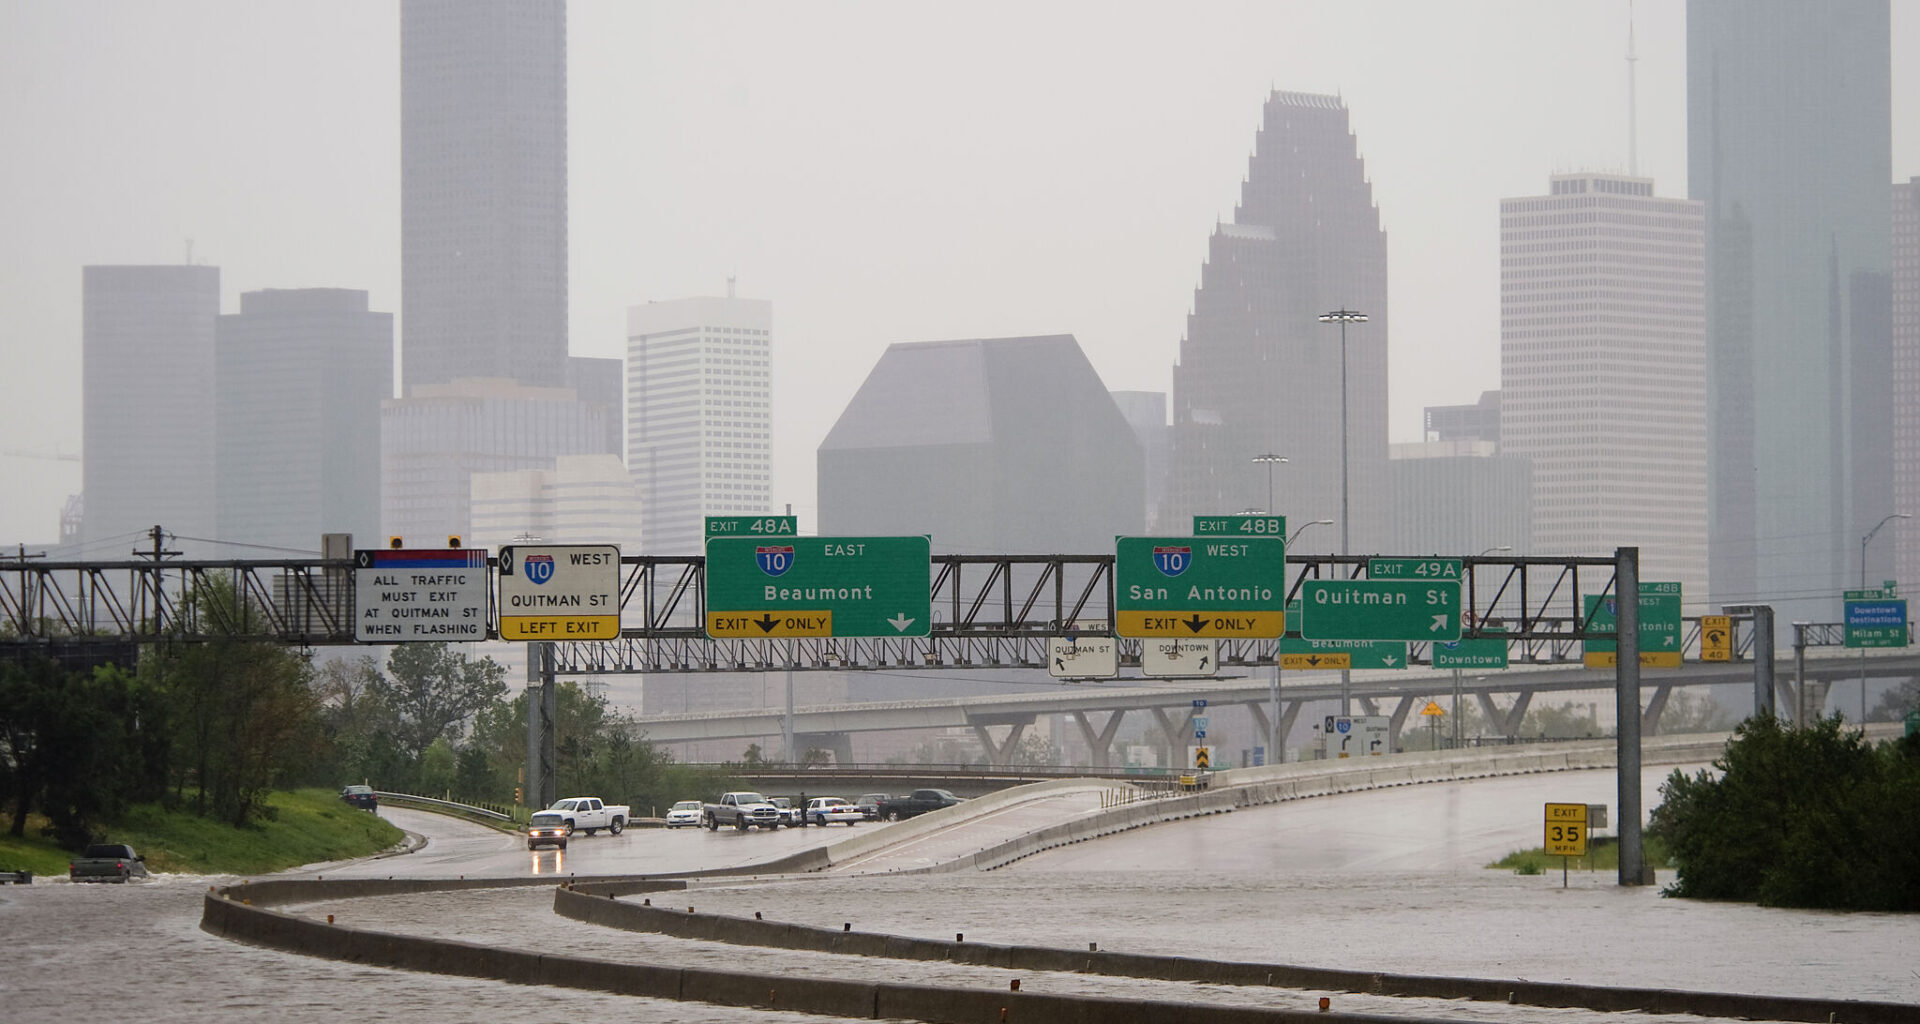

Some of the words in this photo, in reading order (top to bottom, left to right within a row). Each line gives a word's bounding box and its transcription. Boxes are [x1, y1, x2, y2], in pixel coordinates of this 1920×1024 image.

[711, 522, 738, 532] EXIT
[751, 519, 791, 533] 48A
[1200, 521, 1227, 531] EXIT
[1240, 519, 1279, 533] 48B
[825, 545, 865, 556] EAST
[1207, 545, 1248, 556] WEST
[570, 553, 611, 565] WEST
[765, 553, 785, 570] 10
[1162, 553, 1183, 570] 10
[530, 562, 550, 579] 10
[1374, 564, 1402, 574] EXIT
[1415, 563, 1456, 577] 49A
[373, 576, 398, 585] ALL
[411, 575, 466, 585] TRAFFIC
[764, 585, 872, 600] Beaumont
[1130, 585, 1167, 600] San
[1188, 585, 1272, 600] Antonio
[1655, 583, 1678, 592] 48B
[382, 592, 417, 601] MUST
[429, 592, 457, 601] EXIT
[511, 595, 580, 607] QUITMAN
[589, 594, 608, 606] ST
[1315, 589, 1406, 605] Quitman
[1426, 590, 1448, 605] St
[364, 608, 379, 618] AT
[391, 608, 449, 618] QUITMAN
[462, 607, 478, 617] ST
[715, 618, 749, 630] EXIT
[785, 618, 826, 630] ONLY
[1144, 618, 1177, 630] EXIT
[1214, 618, 1256, 630] ONLY
[1849, 616, 1902, 624] Destinations
[365, 624, 402, 634] WHEN
[413, 624, 478, 634] FLASHING
[520, 622, 557, 633] LEFT
[566, 622, 600, 633] EXIT
[1591, 622, 1615, 631] San
[1852, 630, 1882, 638] Milam
[1889, 630, 1900, 638] St
[1056, 646, 1095, 654] QUITMAN
[1159, 644, 1209, 652] DOWNTOWN
[1283, 657, 1303, 665] EXIT
[1324, 657, 1347, 665] ONLY
[1439, 655, 1501, 664] Downtown
[1553, 808, 1577, 817] EXIT
[1551, 826, 1579, 842] 35
